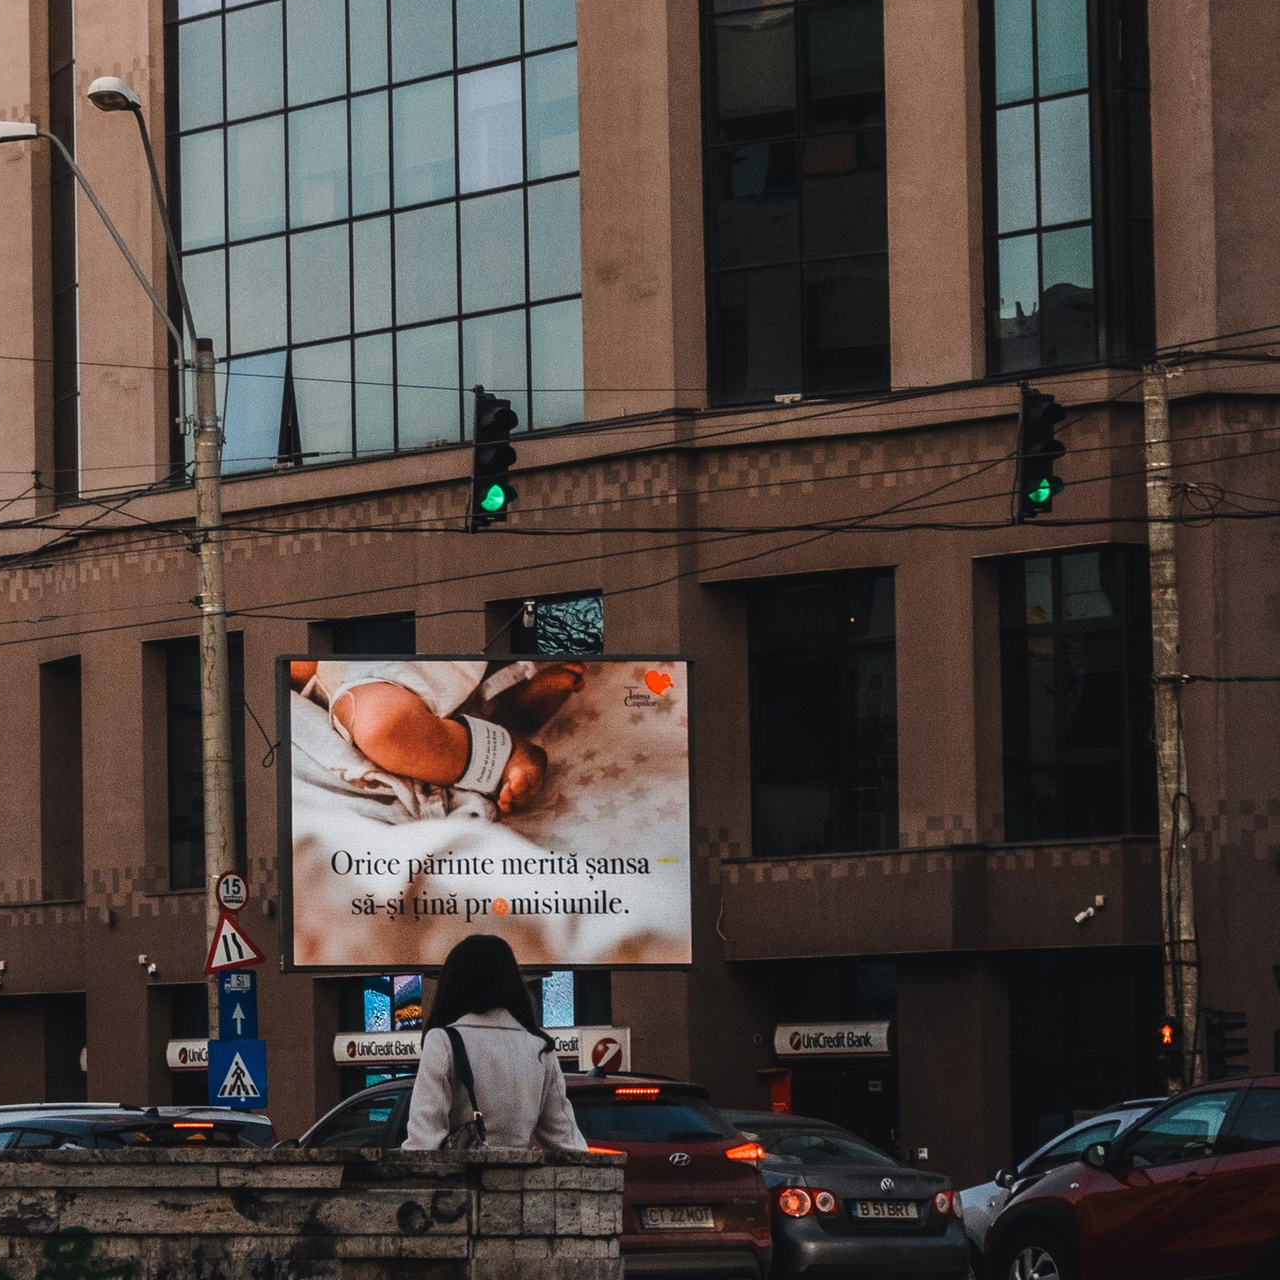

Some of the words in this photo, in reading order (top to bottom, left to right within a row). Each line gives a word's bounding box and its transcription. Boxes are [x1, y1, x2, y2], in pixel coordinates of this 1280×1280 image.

[330, 849, 401, 877] Orice
[407, 849, 495, 884] părinte
[500, 850, 579, 876] merită
[584, 856, 651, 880] șansa
[222, 878, 241, 895] 15
[350, 890, 405, 923] să-și
[412, 890, 458, 921] țină
[357, 1040, 394, 1056] UniCredit
[395, 1040, 416, 1056] Bank
[802, 1032, 846, 1049] UniCredit
[847, 1031, 872, 1048] Bank
[649, 1208, 665, 1223] CT
[669, 1208, 685, 1222] 22
[861, 1202, 870, 1216] B
[873, 1202, 885, 1216] 51
[887, 1202, 910, 1216] BRT
